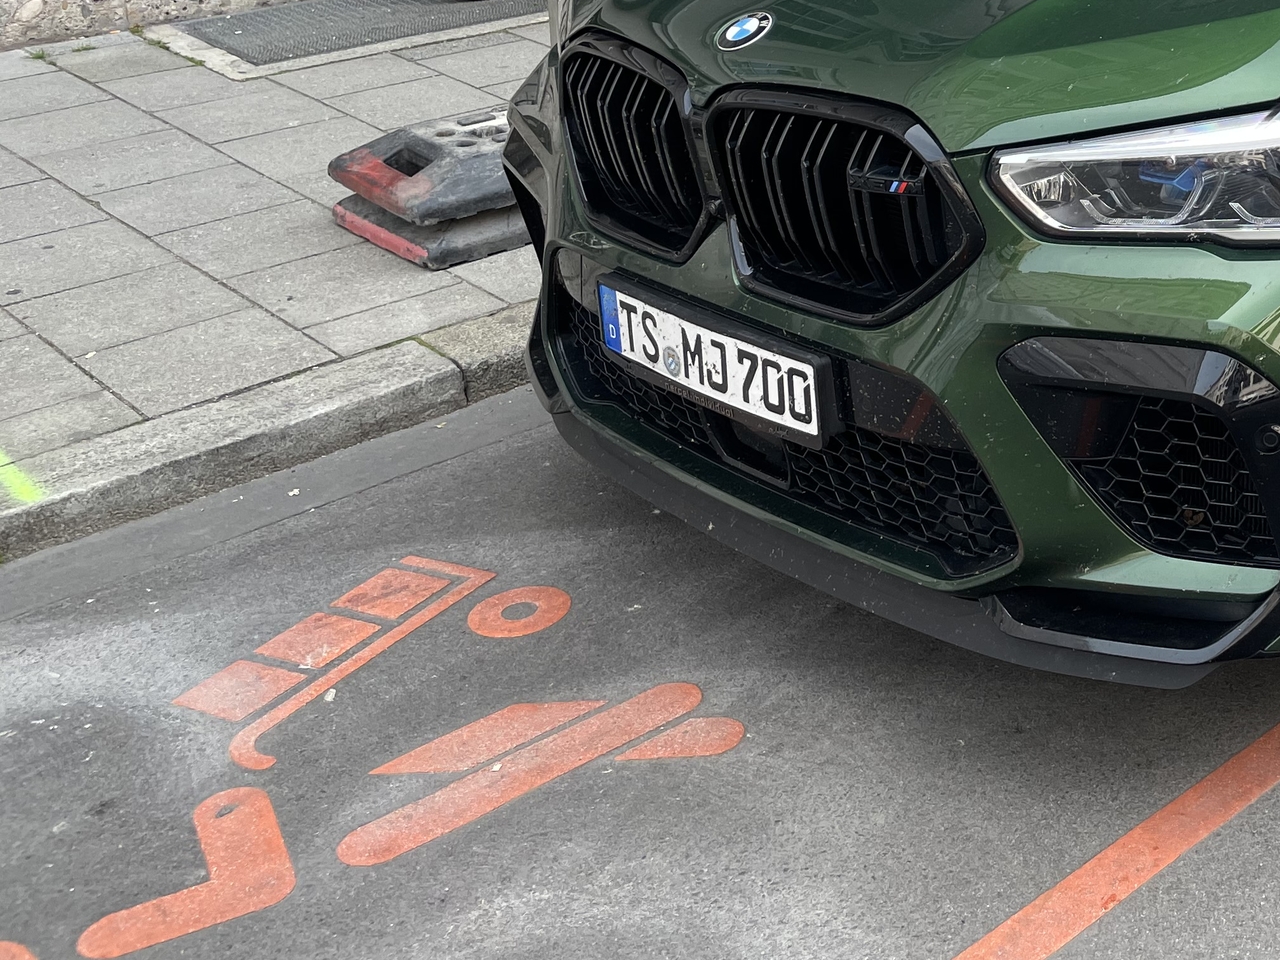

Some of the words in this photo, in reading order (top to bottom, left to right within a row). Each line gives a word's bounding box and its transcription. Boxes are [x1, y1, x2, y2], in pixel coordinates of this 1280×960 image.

[608, 323, 617, 339] D
[619, 299, 660, 364] TS
[681, 326, 729, 394] MJ
[737, 348, 813, 425] 700
